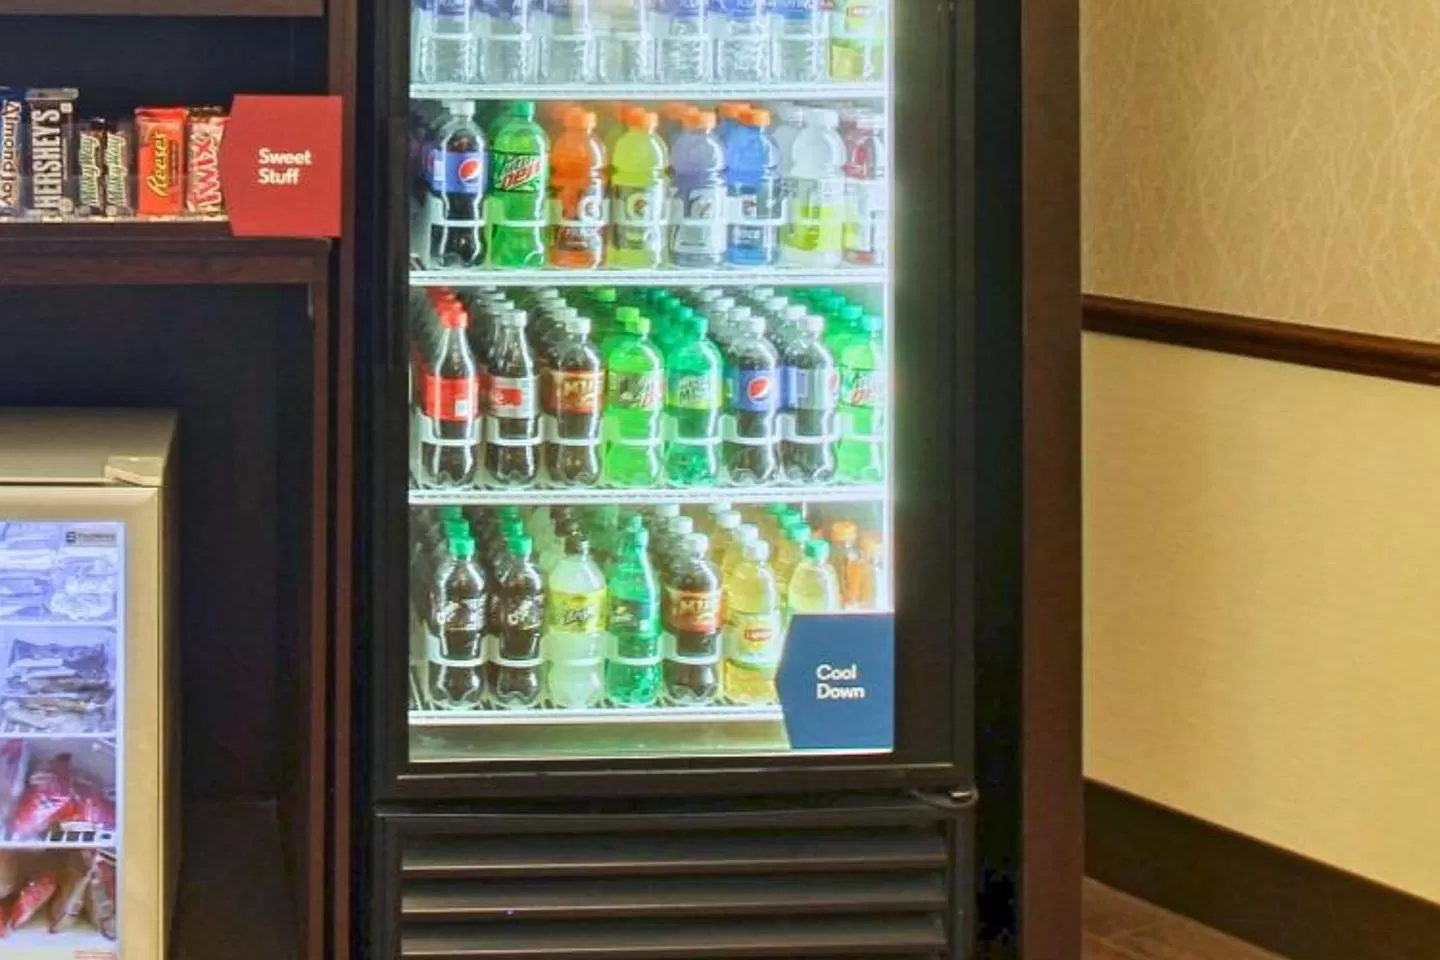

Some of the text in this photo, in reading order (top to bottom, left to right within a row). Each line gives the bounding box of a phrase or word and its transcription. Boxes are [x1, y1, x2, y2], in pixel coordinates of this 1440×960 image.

[0, 101, 20, 205] Almond Joy
[259, 148, 312, 166] Sweet
[259, 168, 301, 185] Stuff
[816, 664, 857, 681] Cool
[816, 684, 865, 699] Down
